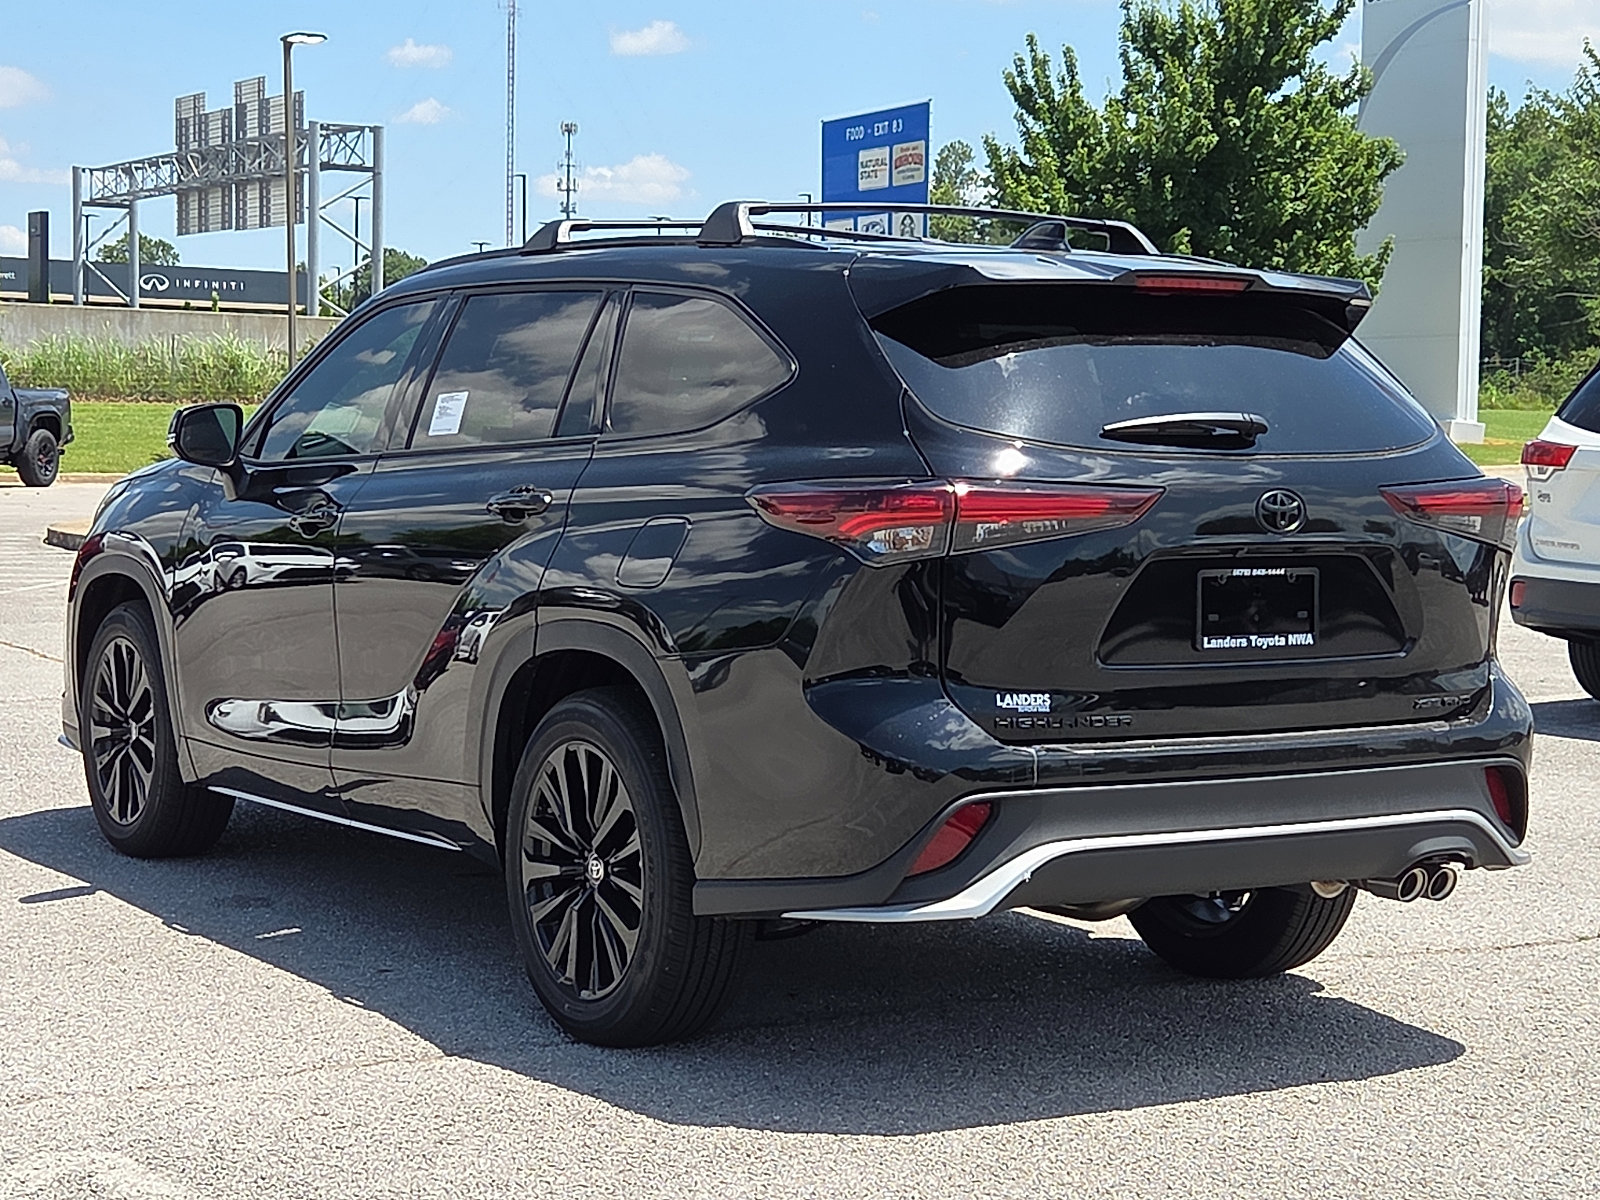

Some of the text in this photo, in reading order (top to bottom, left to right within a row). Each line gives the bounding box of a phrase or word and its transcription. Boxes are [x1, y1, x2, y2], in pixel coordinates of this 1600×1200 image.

[845, 125, 865, 142] FOOD
[873, 121, 889, 137] EXIT
[860, 157, 888, 169] NATURAL
[860, 169, 878, 180] STATE
[175, 278, 245, 292] INFINITI
[1203, 633, 1314, 650] Landers Toyota NWA
[996, 693, 1051, 708] LANDERS
[994, 714, 1133, 729] HIGHLANDER
